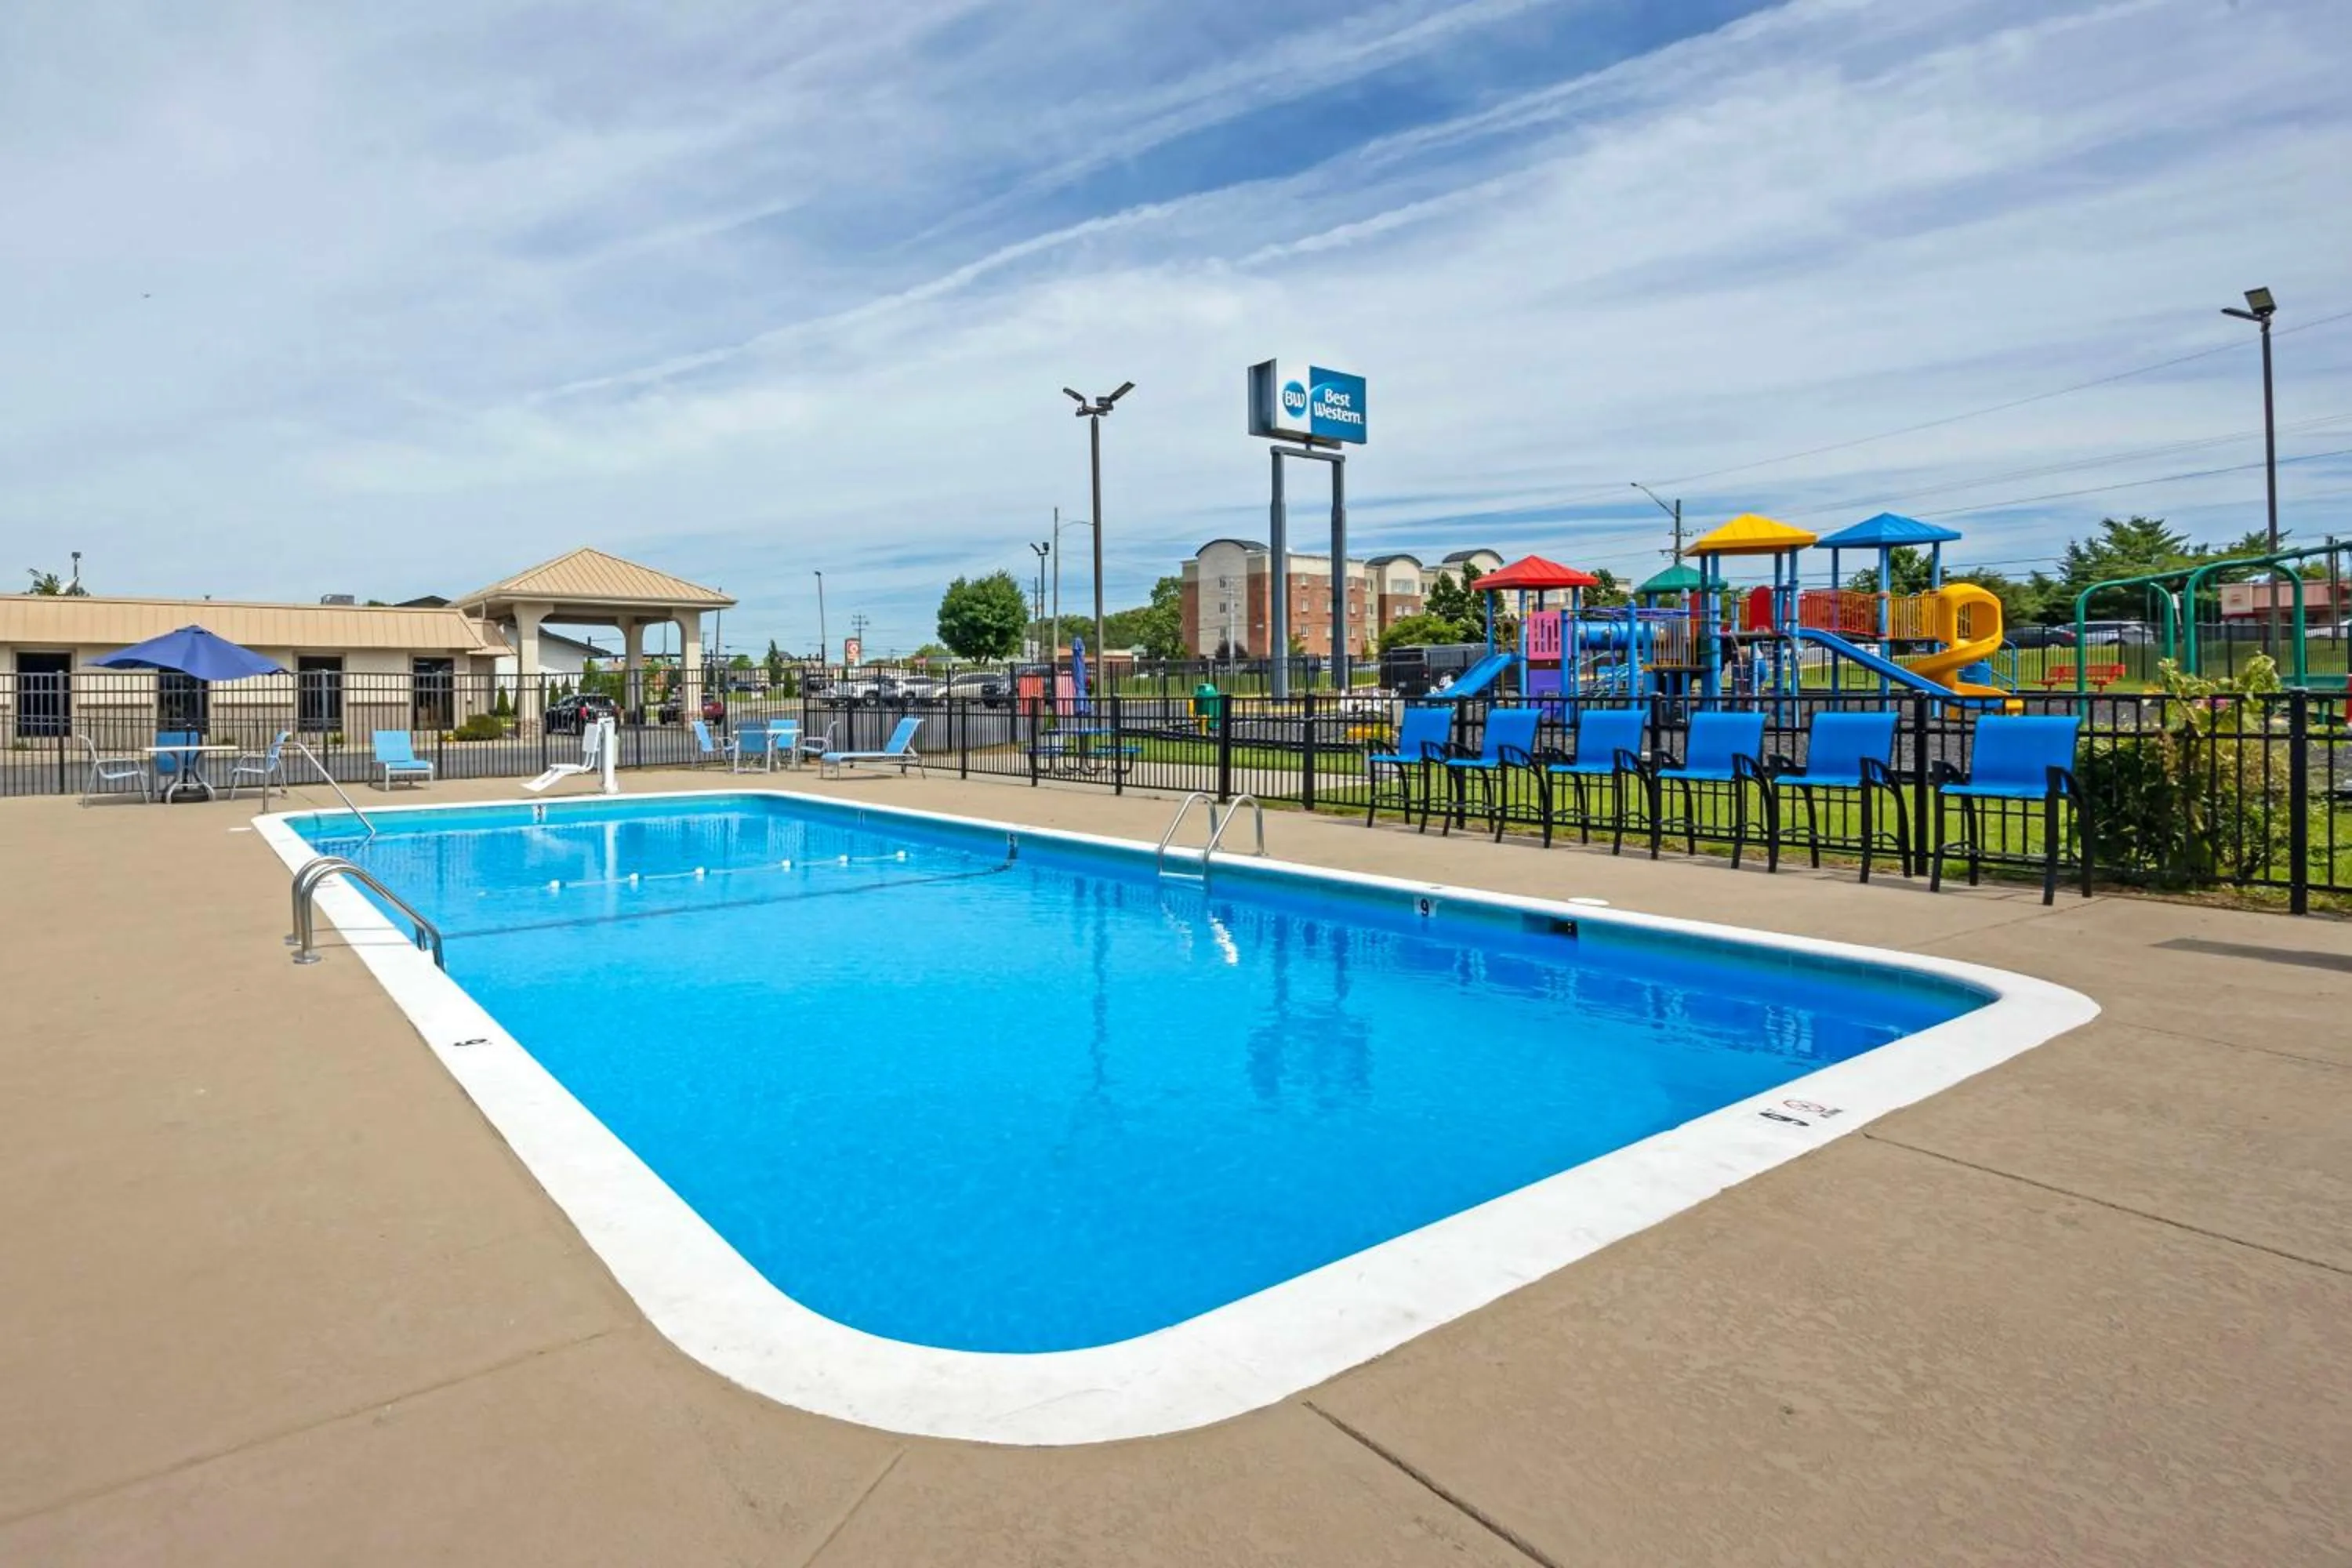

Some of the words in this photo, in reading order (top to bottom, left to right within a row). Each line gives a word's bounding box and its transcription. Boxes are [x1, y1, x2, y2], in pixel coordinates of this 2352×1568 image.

[1284, 390, 1305, 408] BW
[1324, 388, 1351, 407] Best
[1313, 401, 1361, 424] Western
[1420, 898, 1429, 916] 9
